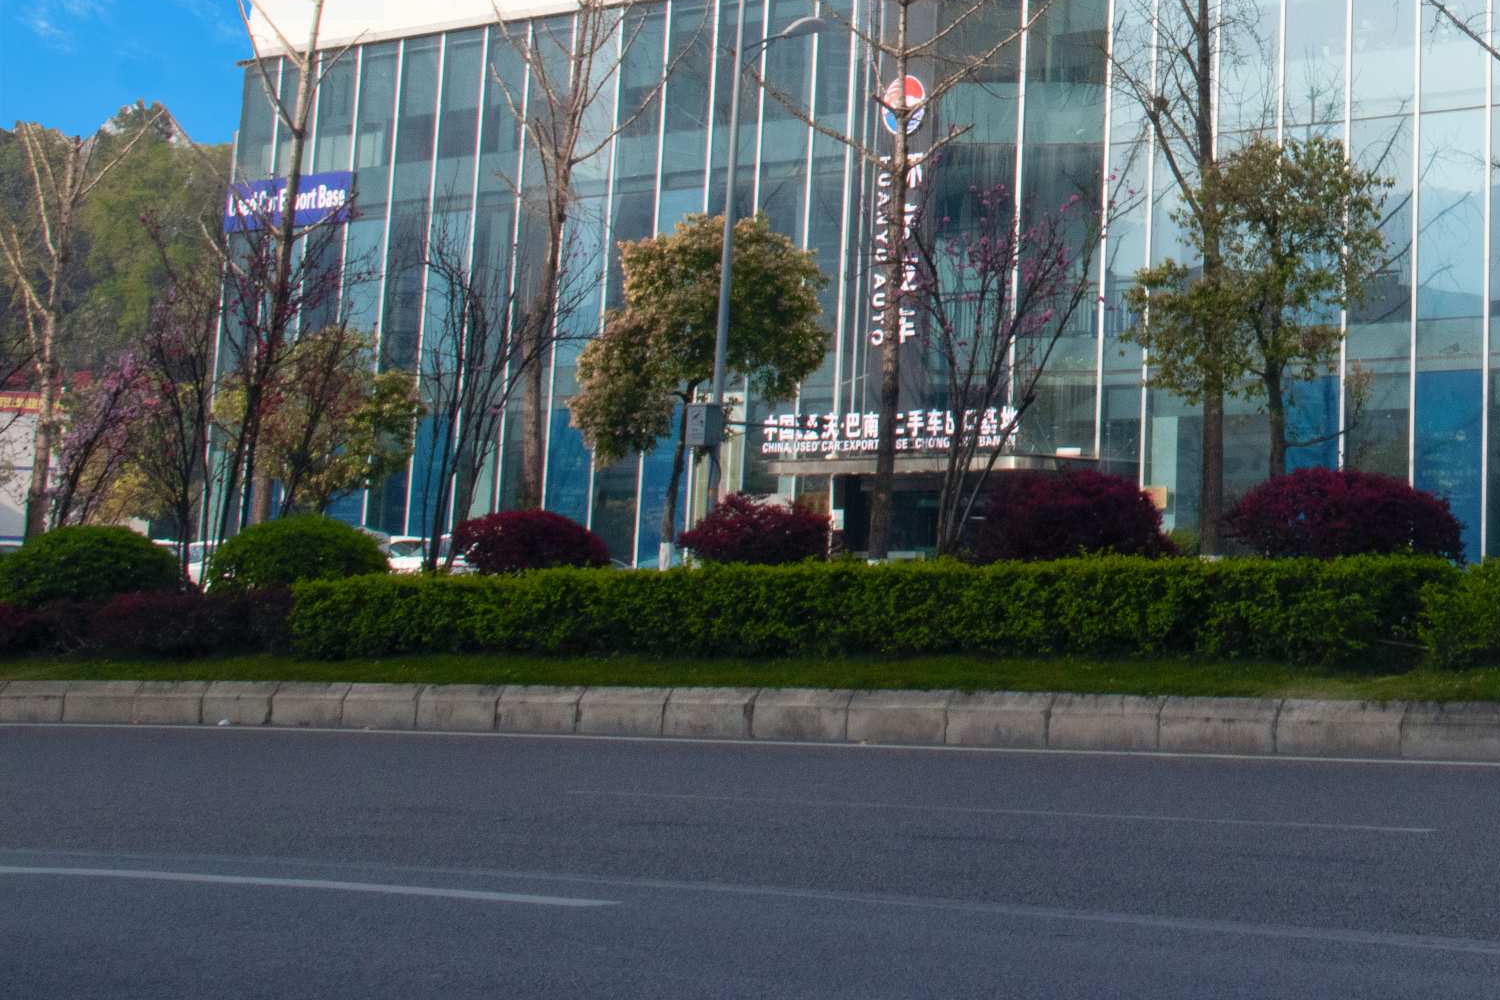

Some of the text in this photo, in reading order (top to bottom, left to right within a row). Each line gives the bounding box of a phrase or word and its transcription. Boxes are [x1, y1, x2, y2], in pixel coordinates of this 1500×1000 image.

[278, 187, 318, 213] Eport
[318, 184, 346, 209] Base
[871, 274, 887, 346] AUTO
[762, 442, 792, 454] CHINA
[793, 441, 819, 452] USED
[821, 440, 840, 452] CAR
[843, 439, 880, 451] EXPORT
[978, 435, 1016, 449] BANN
